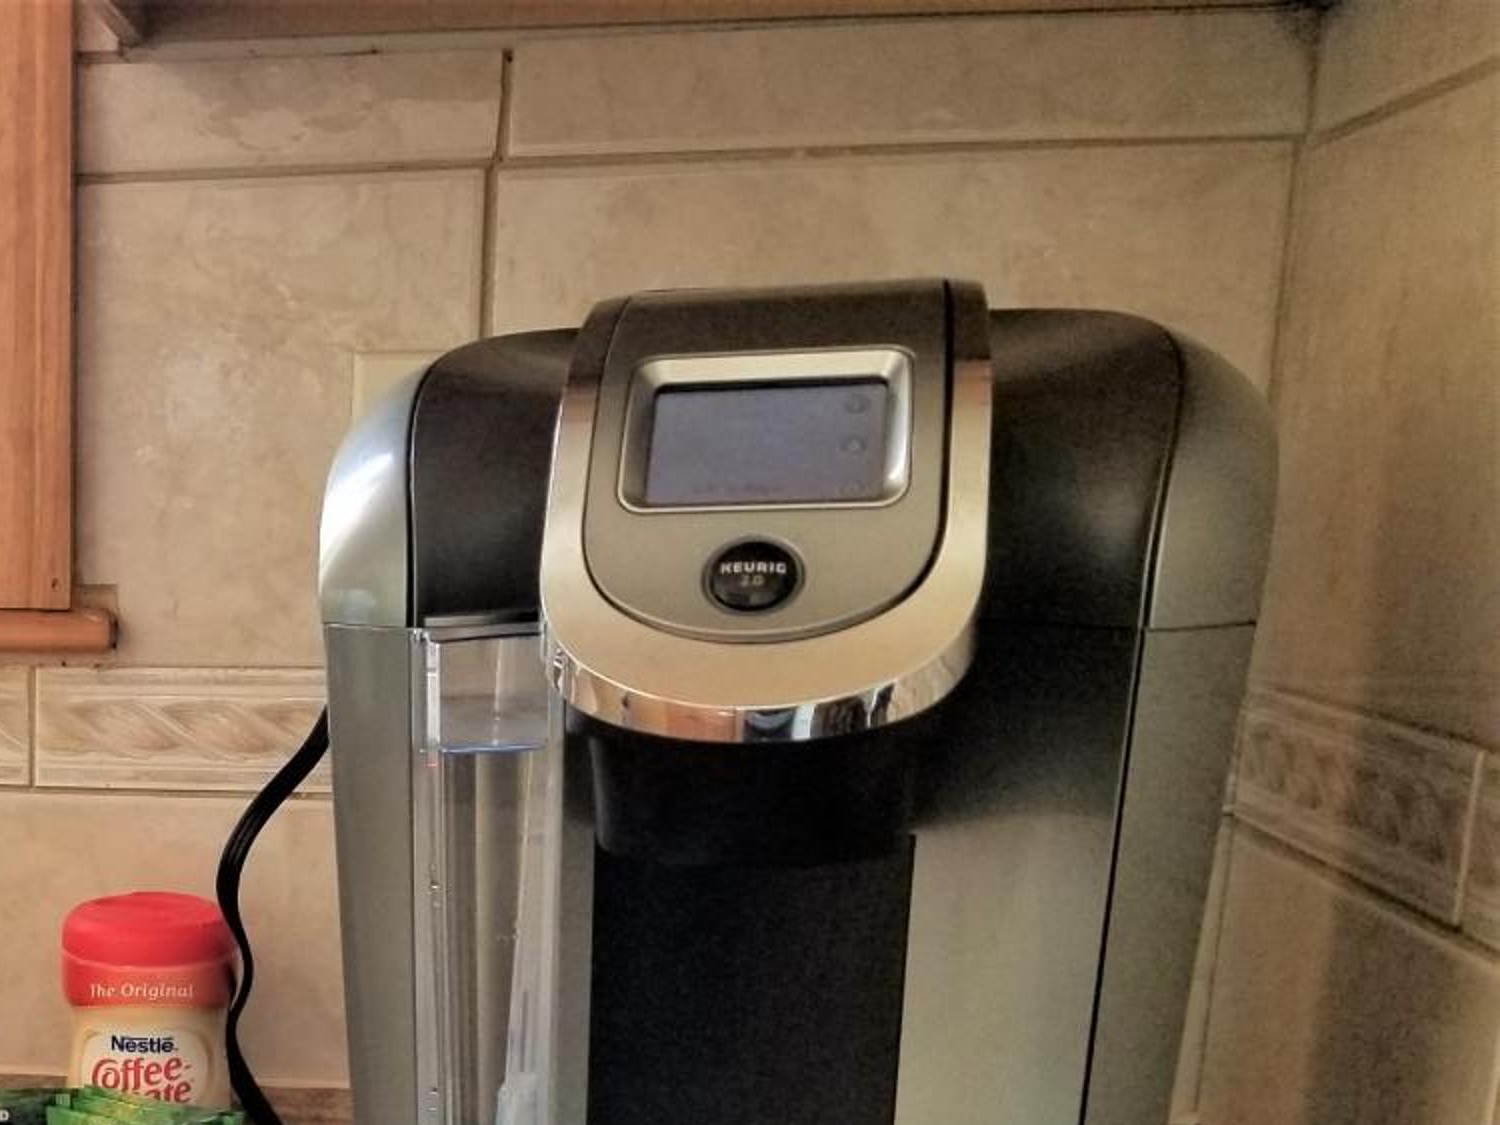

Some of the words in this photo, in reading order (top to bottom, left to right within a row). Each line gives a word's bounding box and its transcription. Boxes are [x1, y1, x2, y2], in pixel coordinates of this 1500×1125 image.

[720, 560, 787, 574] KEURIG
[90, 983, 115, 999] The
[120, 982, 194, 1001] Original
